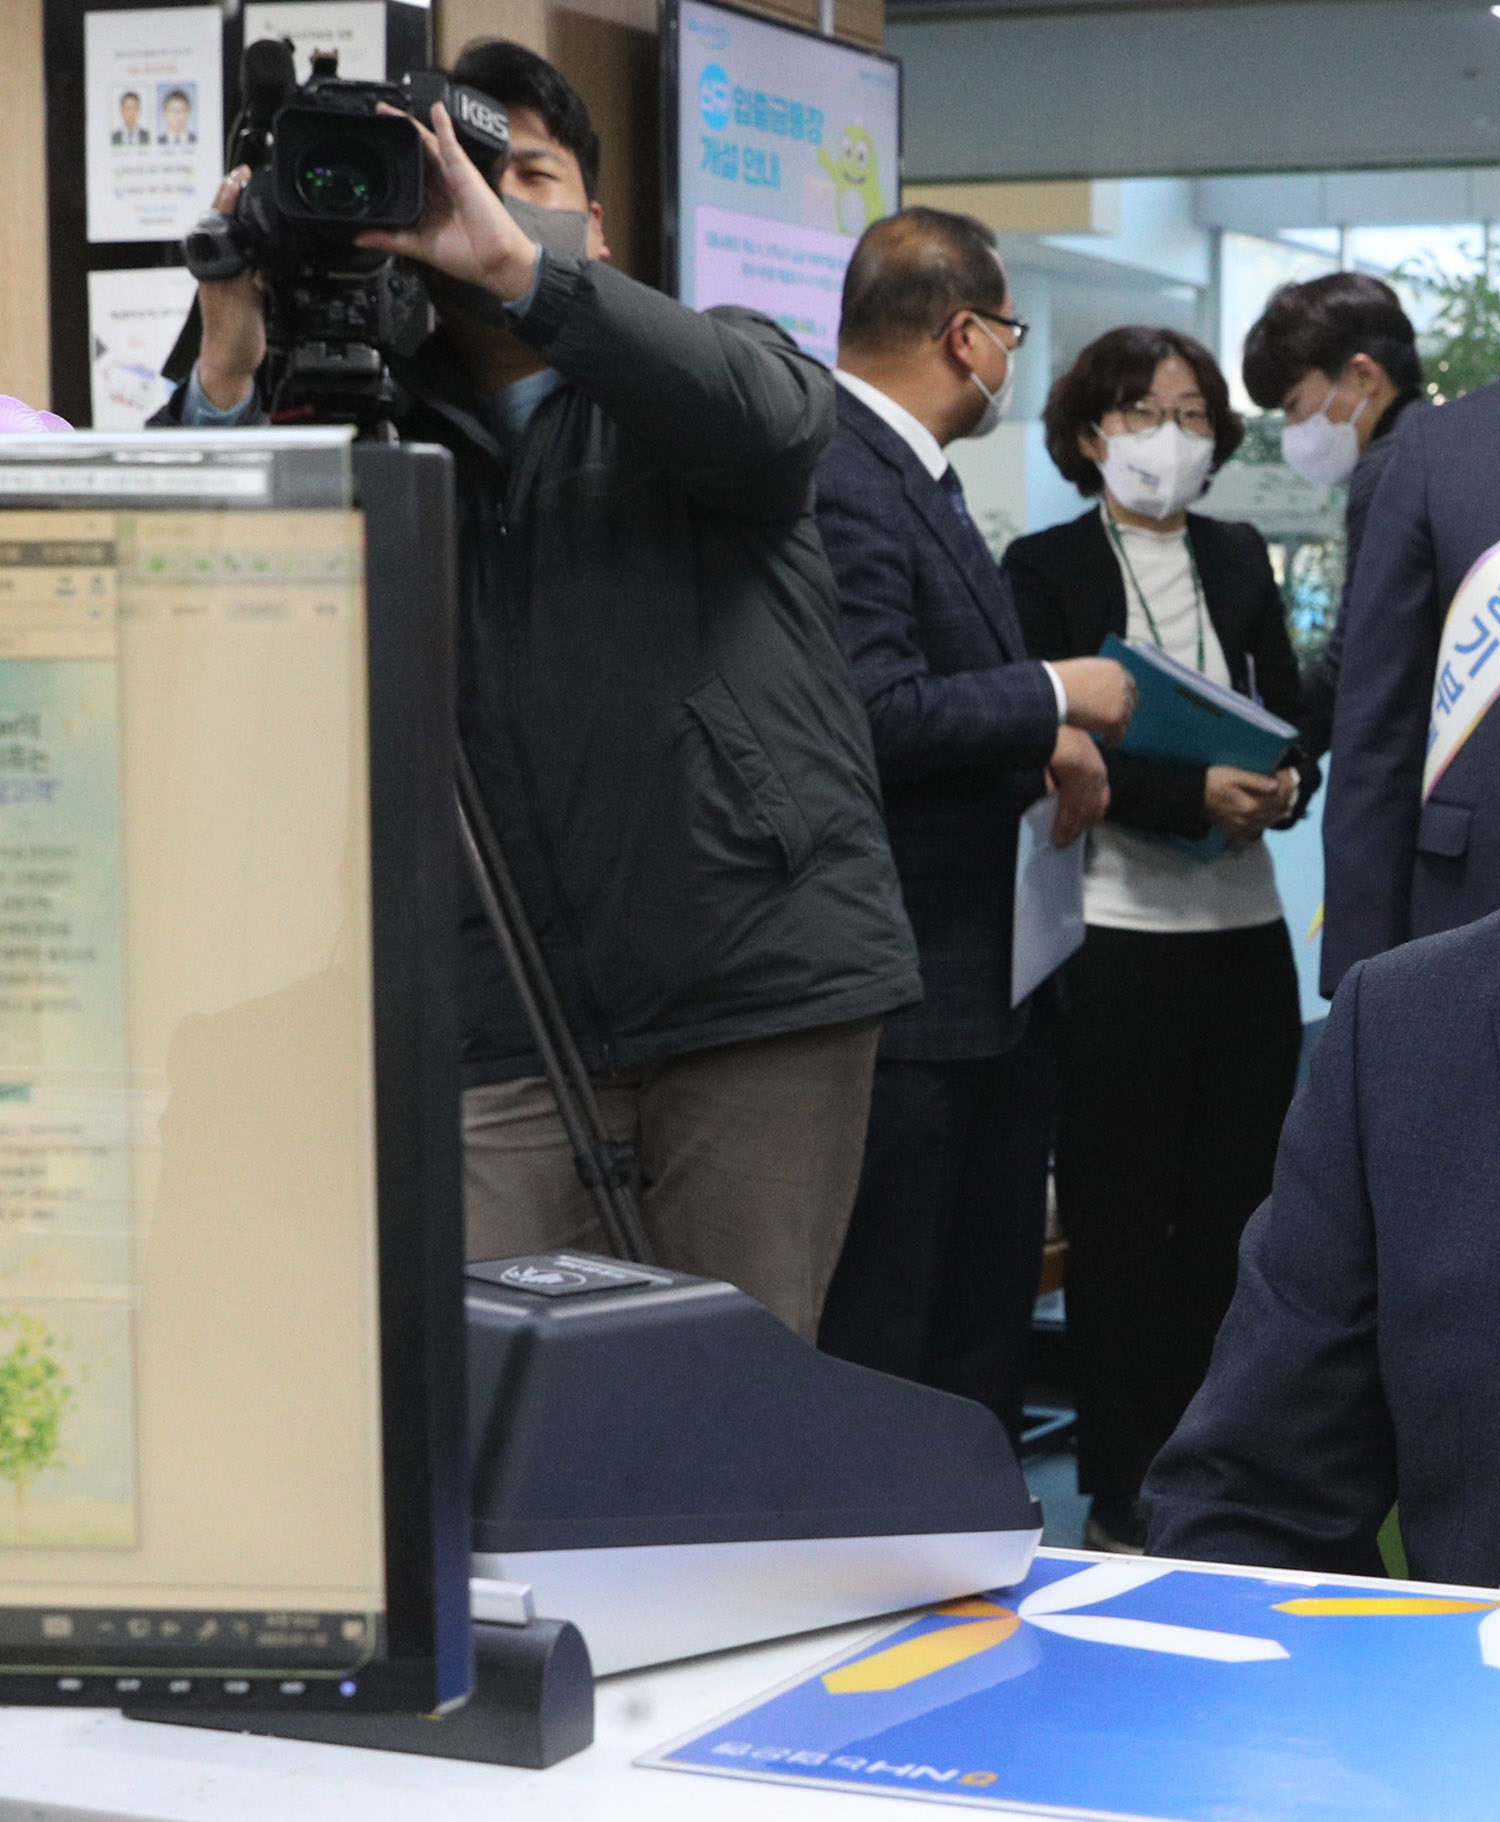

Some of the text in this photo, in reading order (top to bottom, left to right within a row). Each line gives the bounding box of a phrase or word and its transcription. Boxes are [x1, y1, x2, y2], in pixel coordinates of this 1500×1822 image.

[461, 93, 509, 142] KBS
[701, 136, 779, 188] 개설 안내
